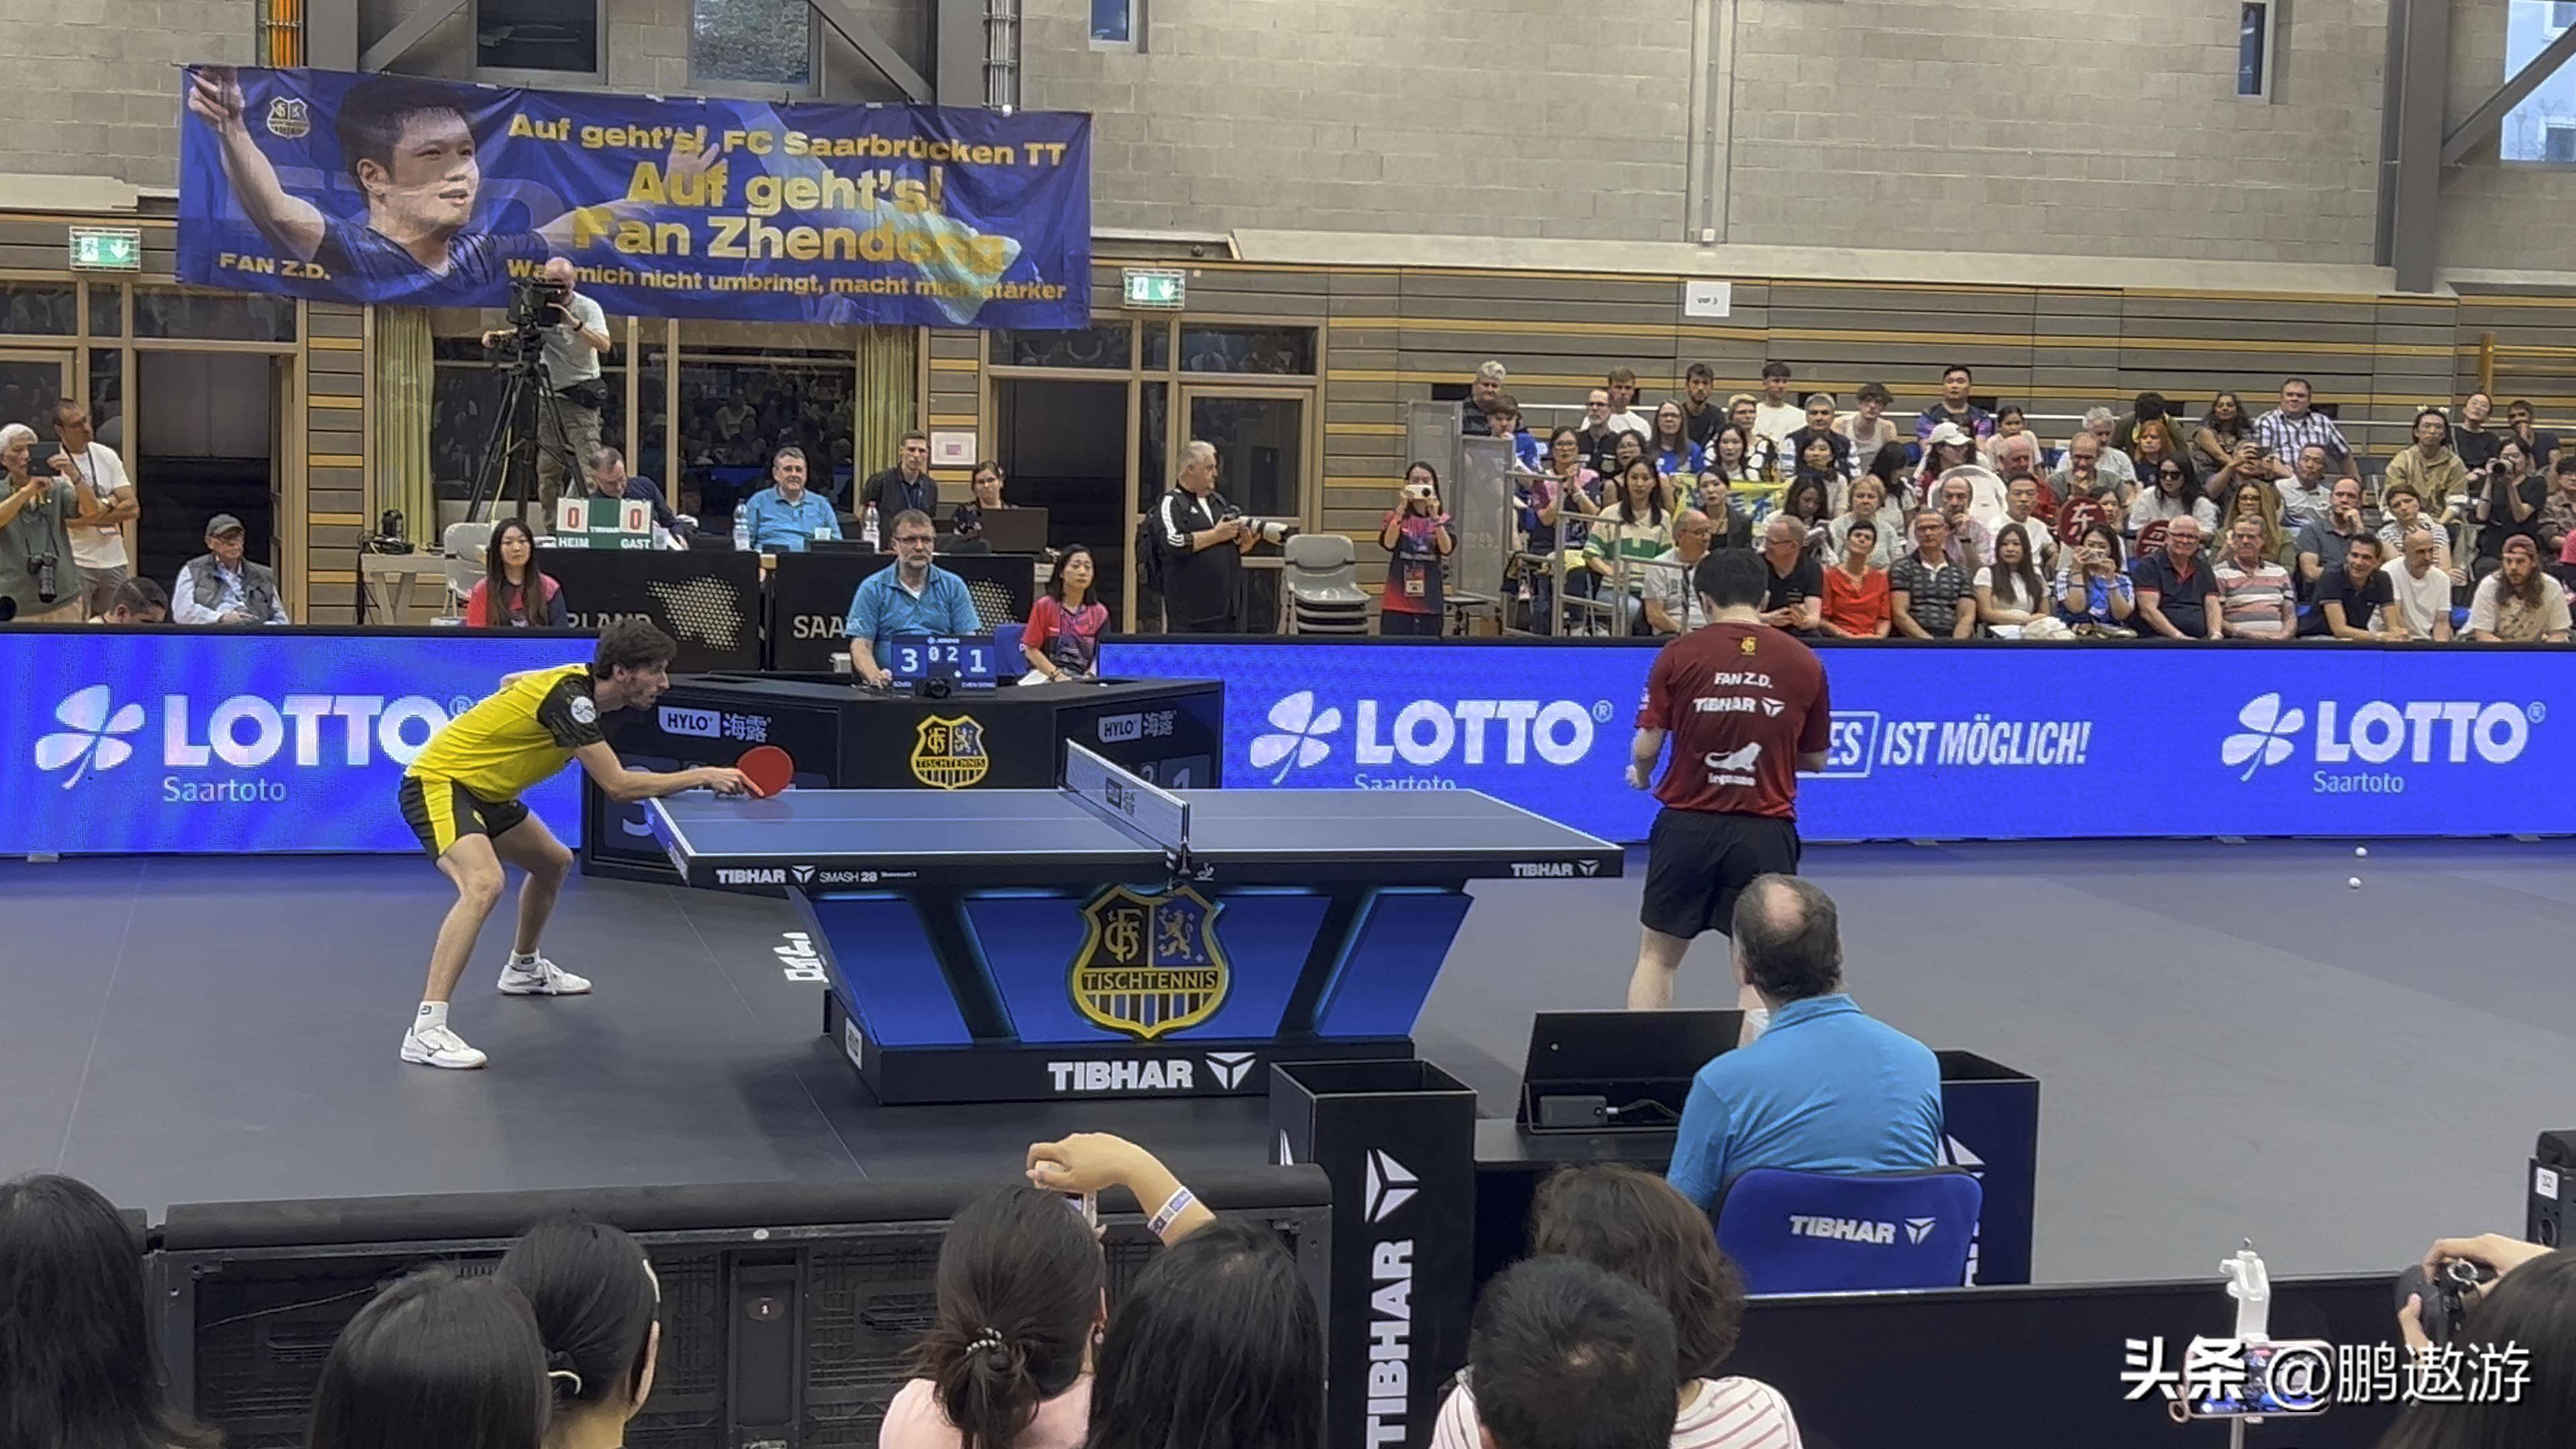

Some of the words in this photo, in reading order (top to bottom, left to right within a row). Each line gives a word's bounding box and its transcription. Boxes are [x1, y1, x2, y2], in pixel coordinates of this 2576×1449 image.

[508, 113, 570, 141] Auf
[722, 129, 773, 155] FC
[784, 131, 1014, 165] Saarbrücken
[1023, 142, 1068, 166] TT
[625, 159, 729, 208] Auf
[745, 165, 943, 217] geht's!
[573, 207, 691, 256] Fan
[707, 215, 1006, 276] Zhendong
[219, 253, 274, 274] FAN
[280, 259, 331, 280] Z.D.
[506, 258, 547, 278] Wa
[574, 265, 634, 285] mich
[640, 269, 702, 290] nicht
[708, 272, 824, 296] umbringt,
[829, 276, 909, 296] macht
[915, 279, 971, 299] mich
[981, 281, 1067, 299] stärker
[568, 507, 580, 529] 0
[629, 508, 642, 530] 0
[558, 537, 590, 548] HEIM
[620, 539, 651, 549] GAST
[793, 614, 847, 639] SAA
[900, 648, 918, 672] 3
[928, 645, 940, 661] 0
[947, 646, 959, 662] 2
[970, 649, 987, 673] 1
[1714, 672, 1741, 686] FAN
[1693, 696, 1756, 713] TIBHAR
[667, 712, 708, 731] HYLO
[1104, 719, 1134, 737] HYLO
[1880, 720, 1937, 765] IST
[1937, 712, 2094, 765] MÖGLICH!
[162, 775, 287, 804] Saartoto
[2312, 769, 2405, 794] Saartoto
[715, 869, 787, 884] TIBHAR
[819, 871, 859, 883] SMASH
[1511, 863, 1574, 877] TIBHAR
[1083, 971, 1218, 991] TISCHTENNIS
[1047, 1059, 1193, 1091] TIBHAR
[1789, 1215, 1896, 1244] TIBHAR
[1366, 1238, 1414, 1449] TIBHAR
